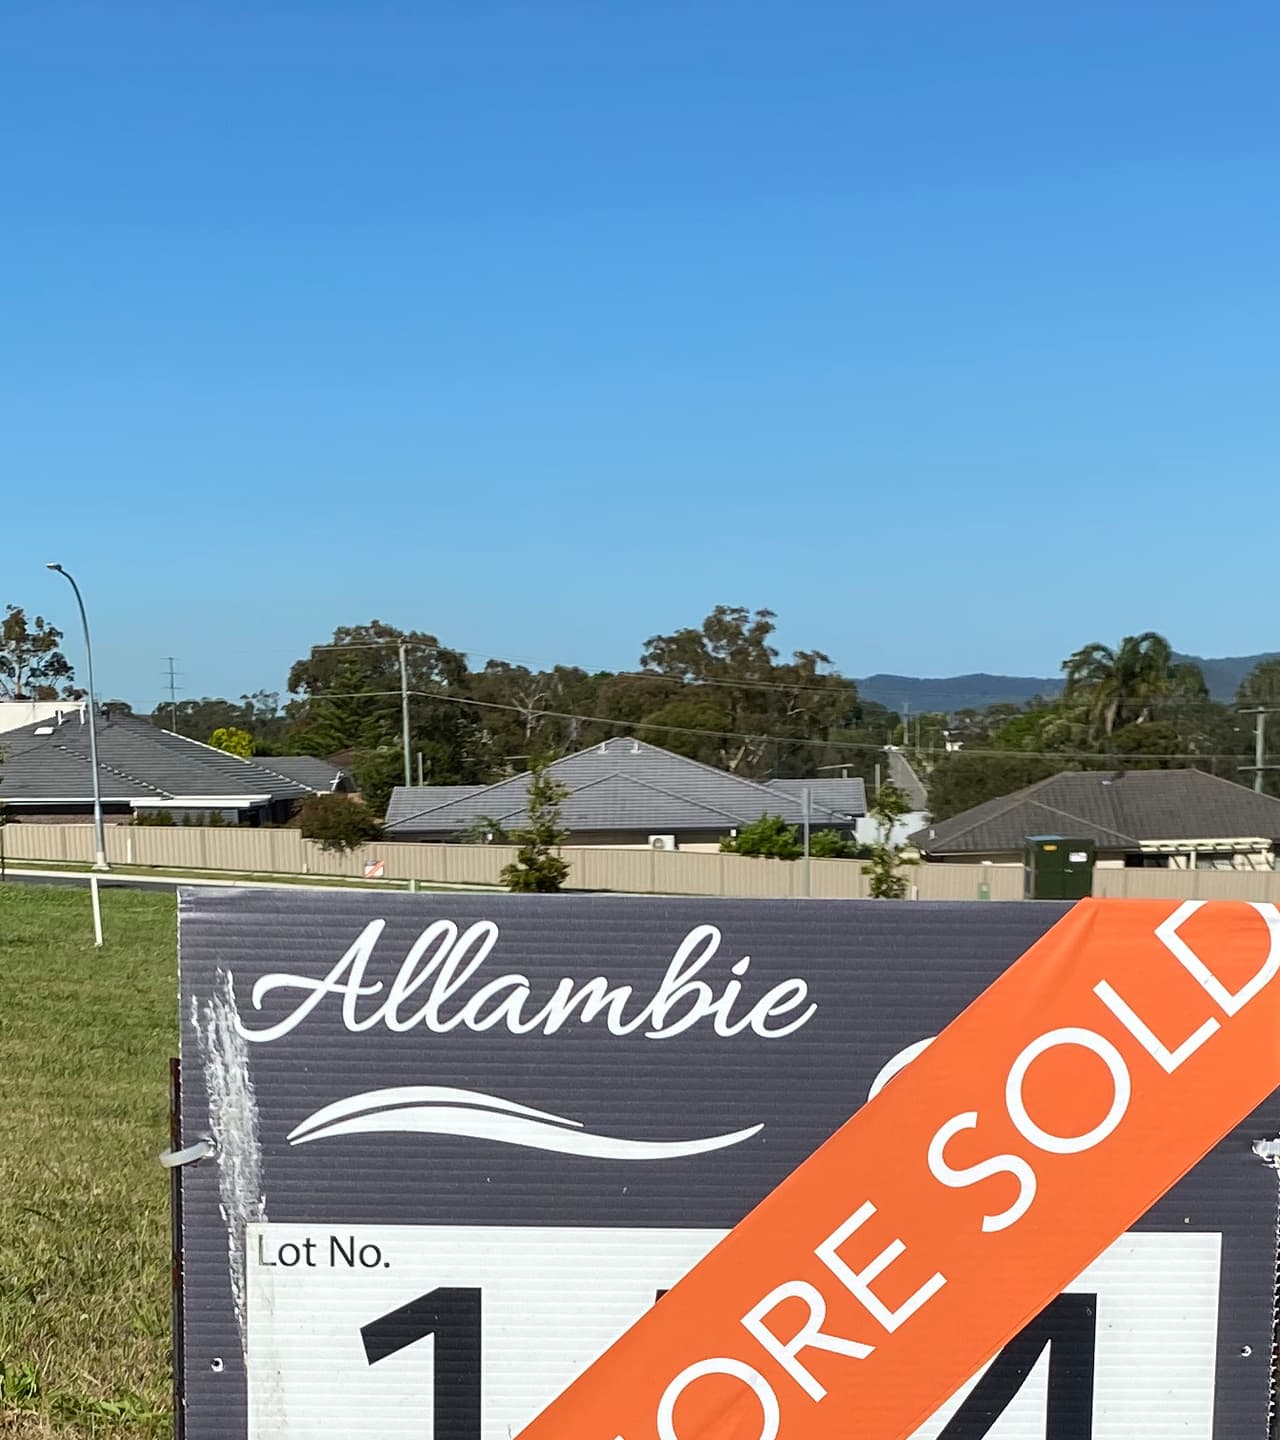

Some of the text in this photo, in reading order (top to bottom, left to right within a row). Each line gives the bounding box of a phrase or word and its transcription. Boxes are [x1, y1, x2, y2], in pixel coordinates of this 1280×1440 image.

[235, 918, 818, 1043] Allambie
[258, 1234, 391, 1269] Lot No.
